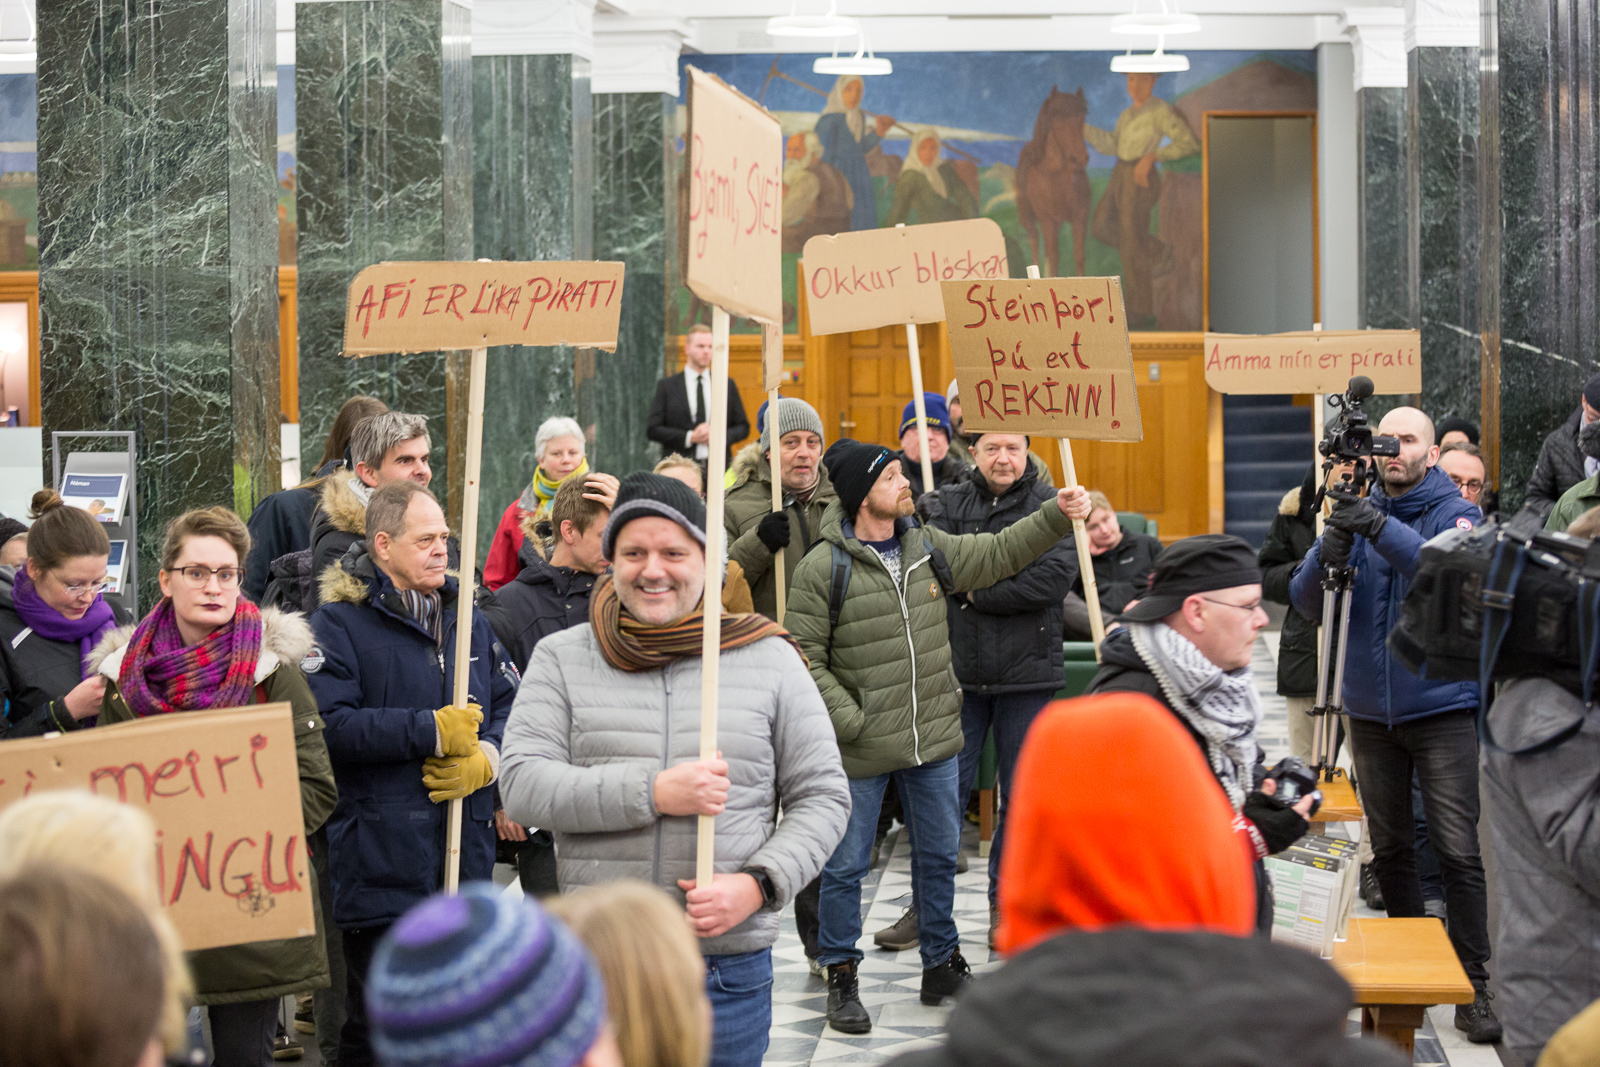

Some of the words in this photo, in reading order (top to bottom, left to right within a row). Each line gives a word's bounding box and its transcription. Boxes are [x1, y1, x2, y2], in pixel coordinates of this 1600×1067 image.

[811, 265, 901, 299] Okkur
[422, 283, 467, 322] ER
[1046, 331, 1091, 370] ert
[1206, 343, 1271, 372] Amma
[1318, 352, 1343, 370] er
[90, 733, 267, 804] meiri
